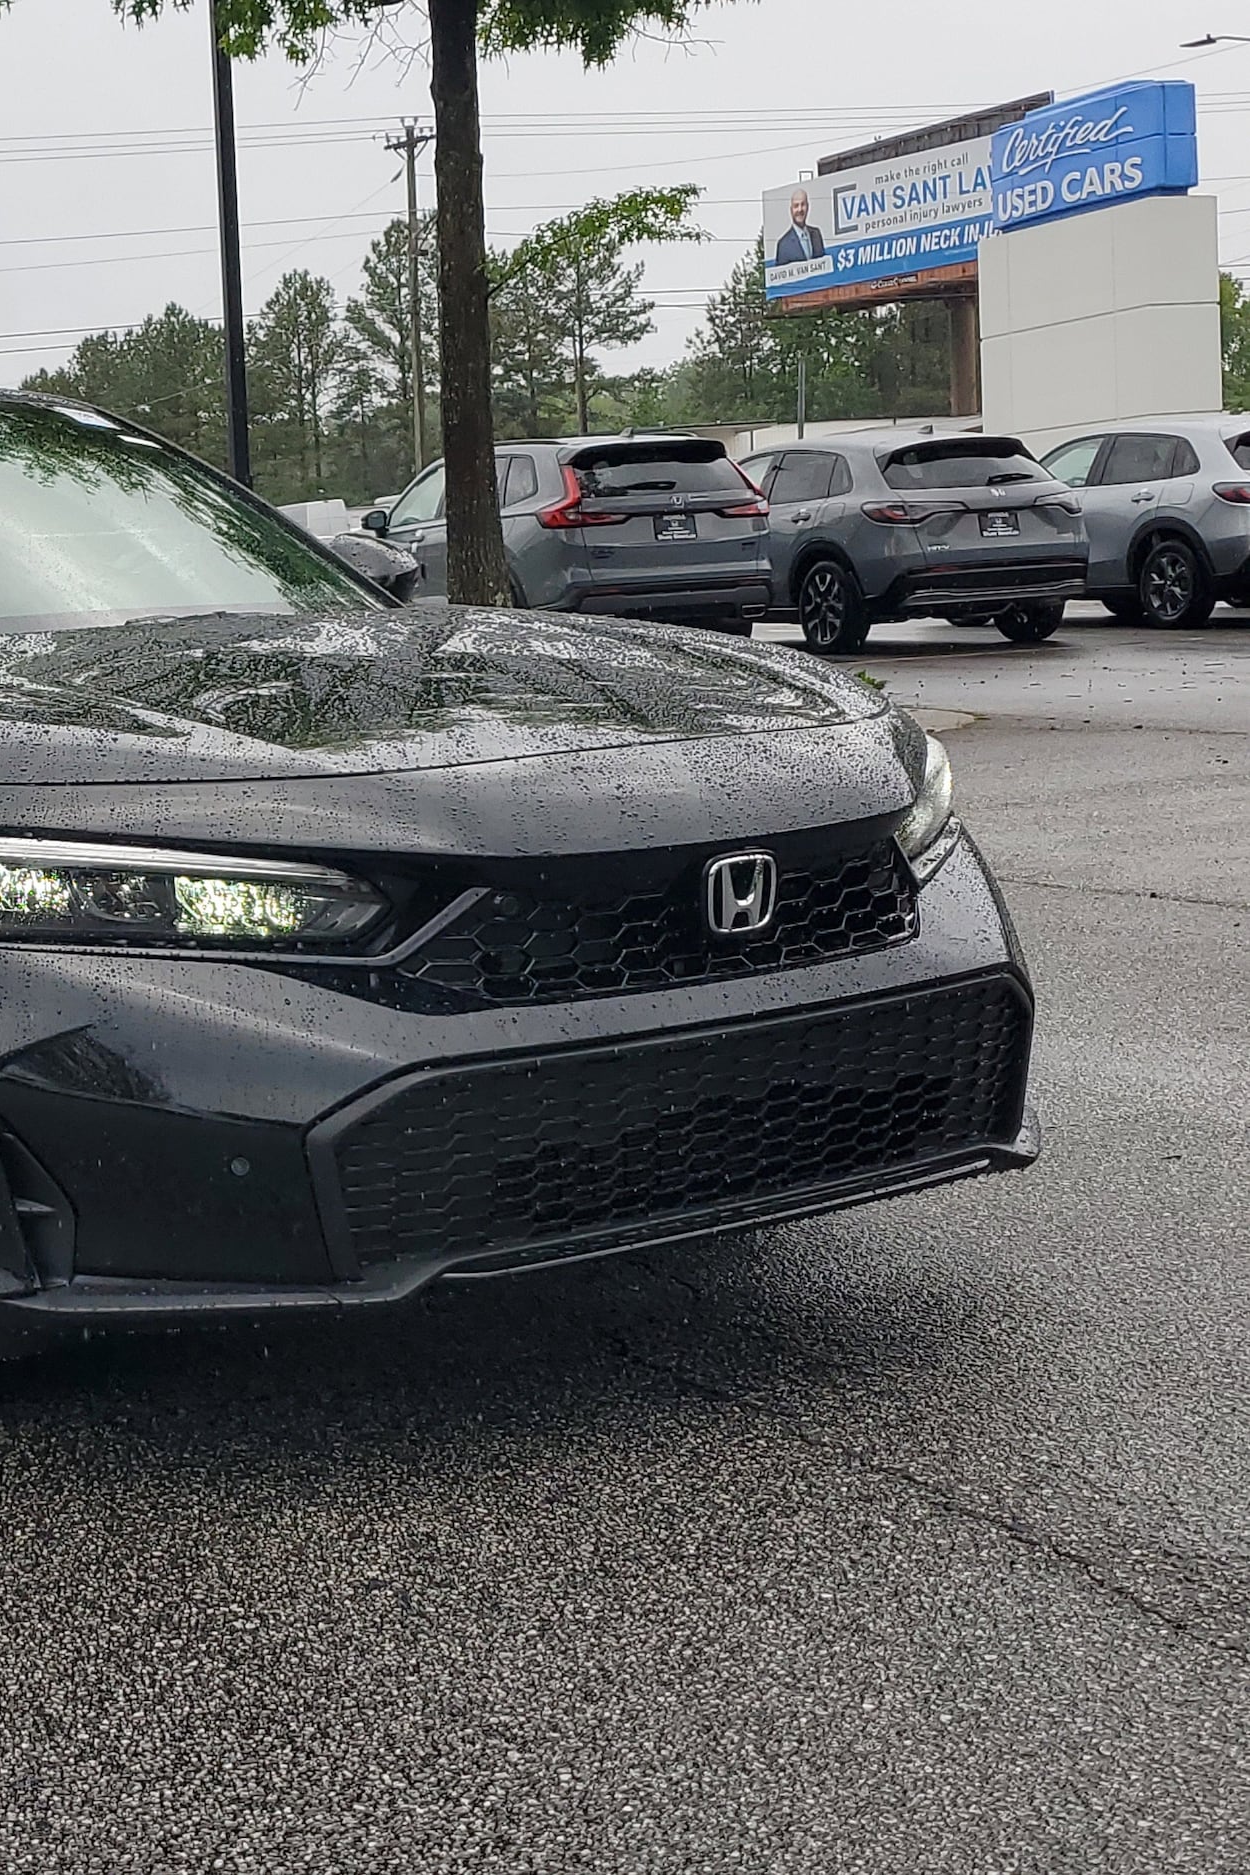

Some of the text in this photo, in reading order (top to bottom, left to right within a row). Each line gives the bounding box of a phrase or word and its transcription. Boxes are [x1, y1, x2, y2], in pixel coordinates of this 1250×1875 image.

[1001, 106, 1134, 176] Certified
[875, 152, 969, 185] make the right call
[997, 156, 1143, 222] USED CARS
[842, 164, 992, 221] VAN SANT LA
[864, 197, 984, 234] personal injury lawyers
[770, 270, 788, 281] DAVID
[796, 265, 809, 276] VAN
[810, 260, 826, 272] SANT
[836, 248, 856, 272] $3
[857, 235, 918, 265] MILLION
[920, 226, 962, 253] NECK
